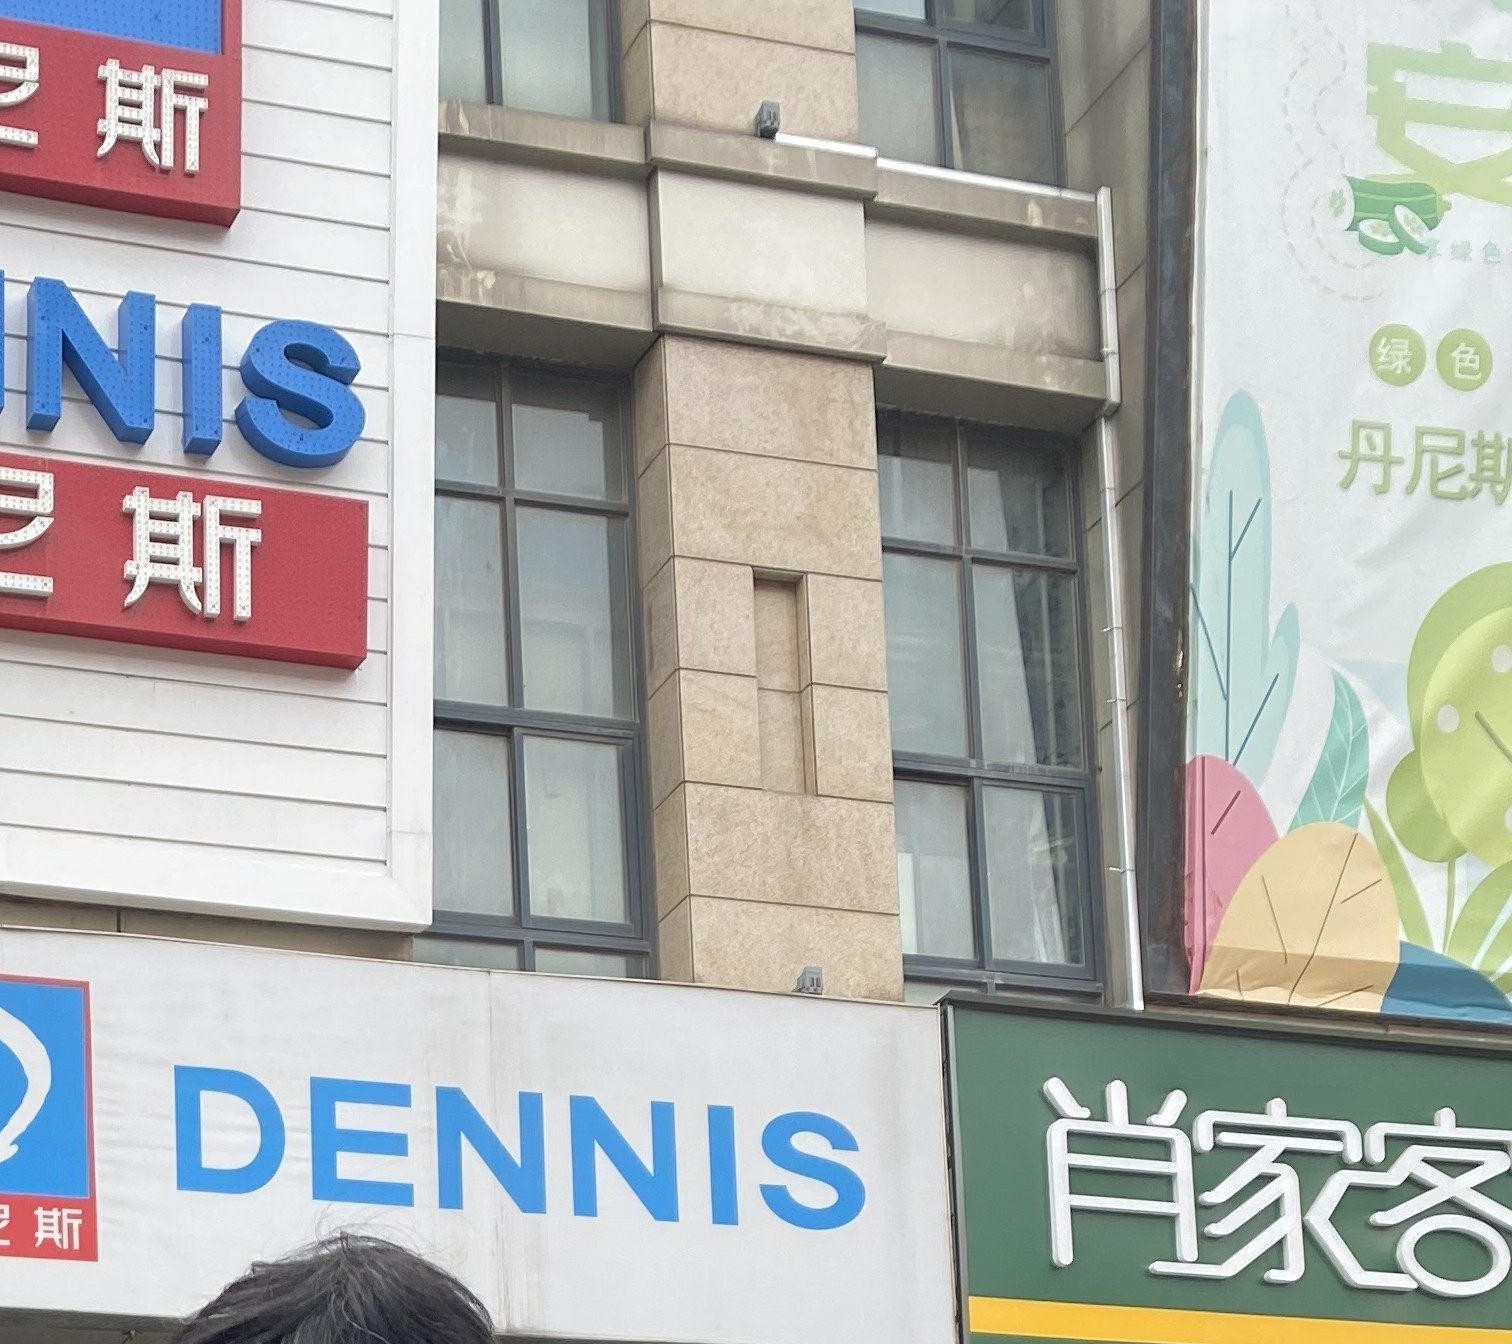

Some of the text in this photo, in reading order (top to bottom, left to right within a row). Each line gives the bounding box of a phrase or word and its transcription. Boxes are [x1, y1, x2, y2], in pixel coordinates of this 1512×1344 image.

[174, 1065, 866, 1230] DENNIS
[1043, 1076, 1512, 1299] 肖家客
